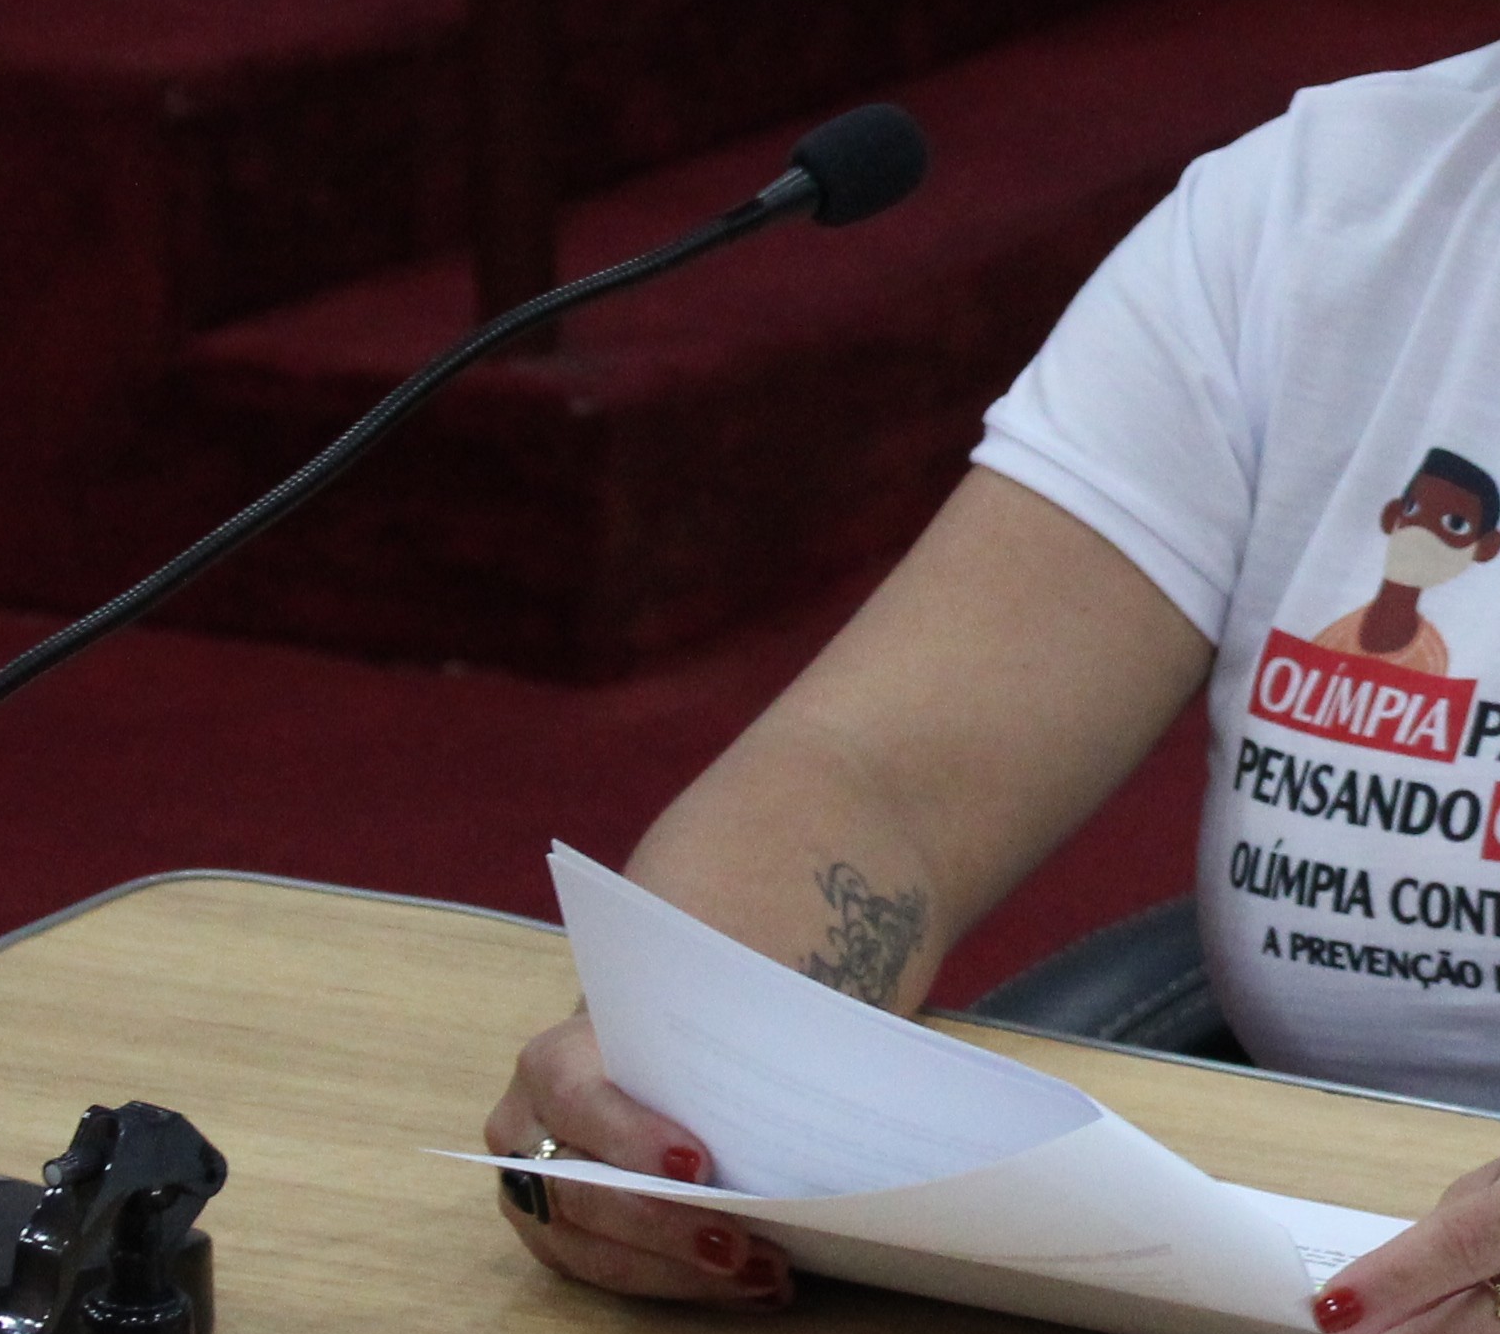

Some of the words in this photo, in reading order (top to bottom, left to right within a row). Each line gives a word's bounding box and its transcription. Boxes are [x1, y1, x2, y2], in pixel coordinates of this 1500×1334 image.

[1257, 656, 1449, 752] OLÍMPIA
[1232, 736, 1481, 843] PENSANDO
[1229, 838, 1375, 919] OLÍMPIA
[1262, 926, 1282, 958] A
[1289, 931, 1484, 989] PREVENÇÃO
